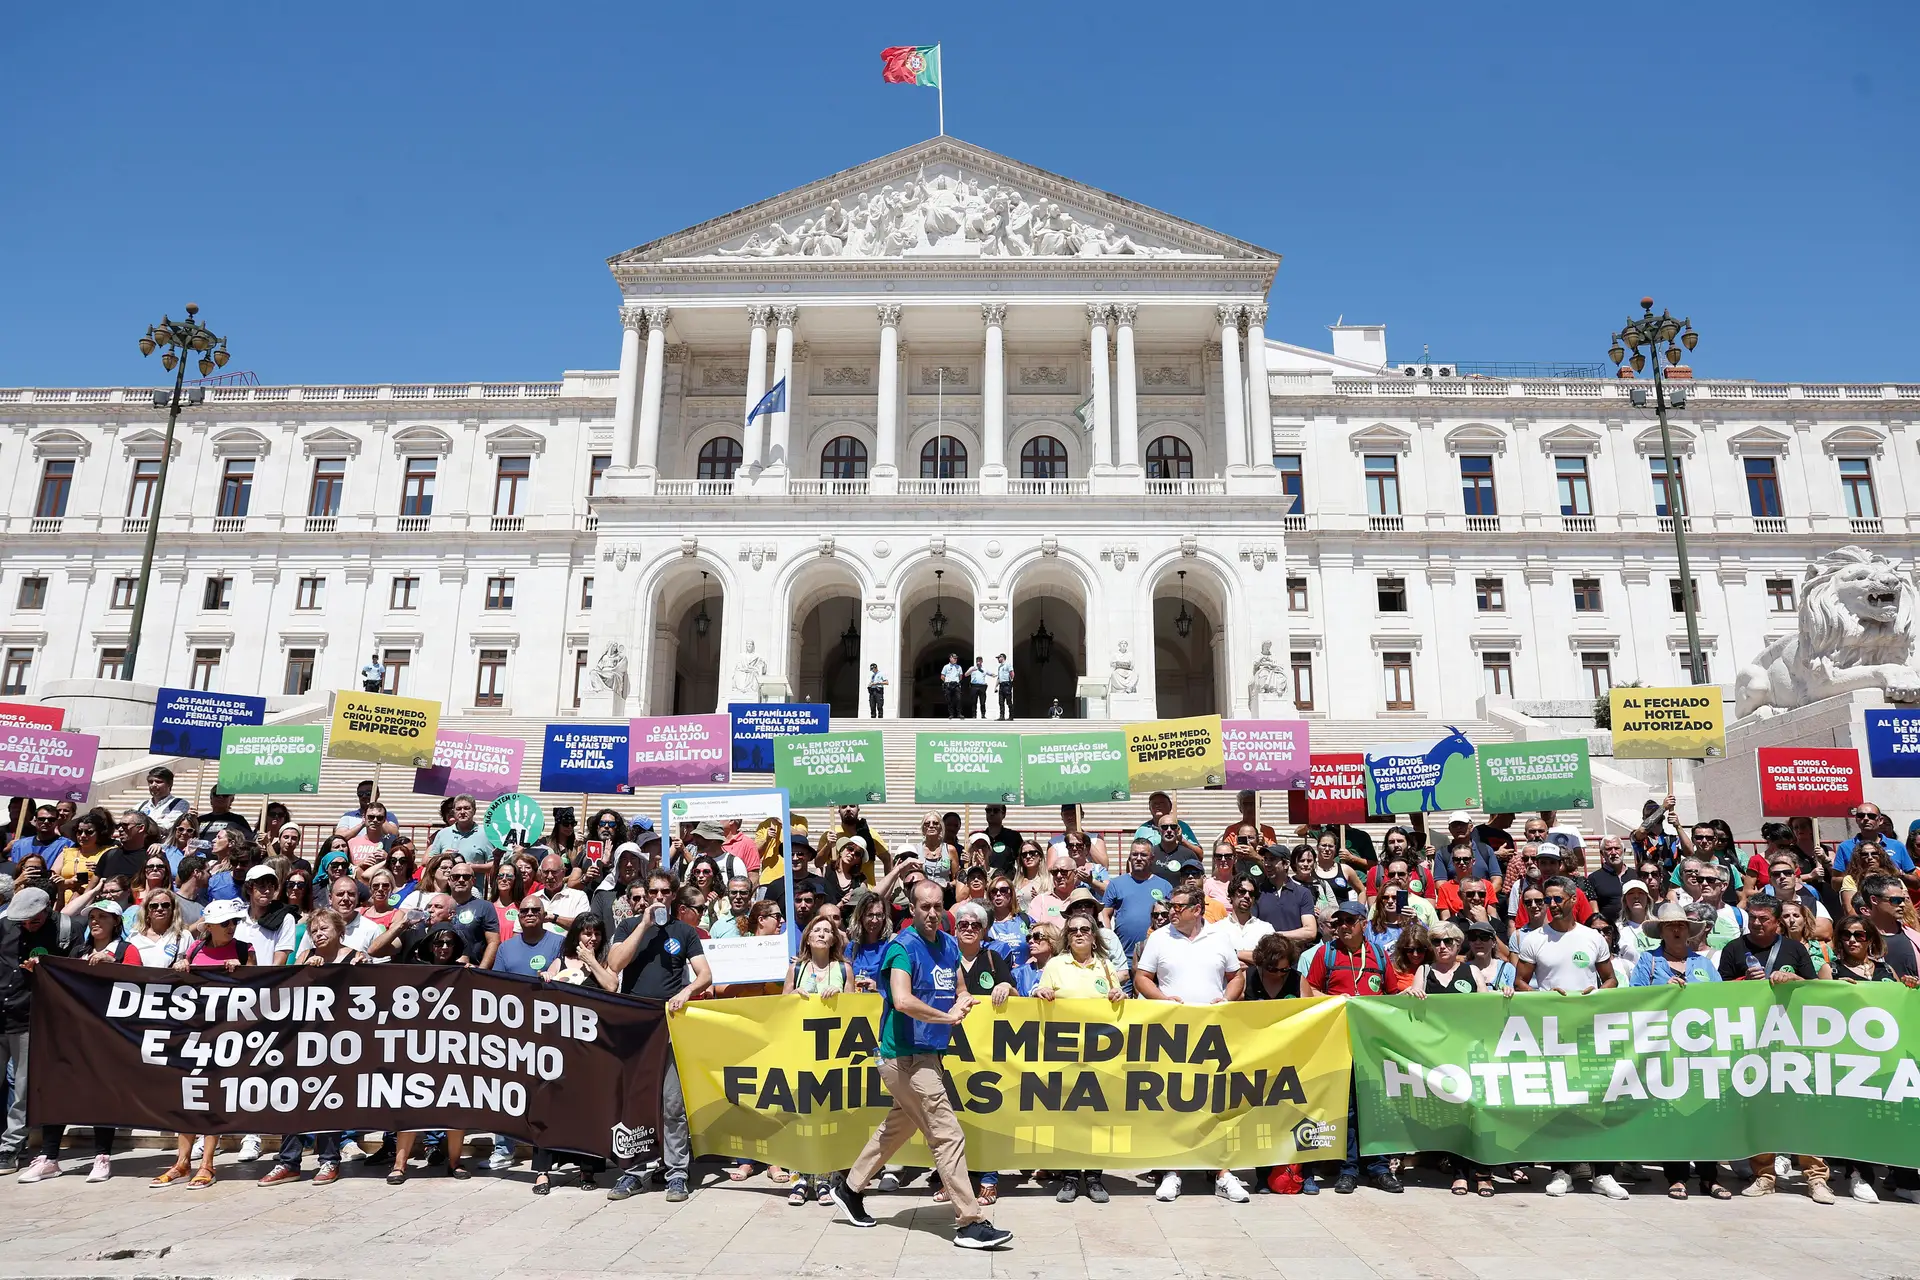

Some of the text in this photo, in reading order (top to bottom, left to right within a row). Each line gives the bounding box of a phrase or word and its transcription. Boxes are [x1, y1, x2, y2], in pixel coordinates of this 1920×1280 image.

[191, 697, 232, 708] FAMÍLIAS
[1623, 698, 1710, 708] AL FECHADO
[167, 703, 252, 717] PORTUGAL PASSAM
[185, 710, 217, 720] FÉRIAS
[357, 705, 372, 713] AL,
[374, 707, 395, 715] SEM
[397, 709, 427, 719] MEDO,
[759, 709, 797, 717] FAMÍLIAS
[1645, 710, 1690, 719] HOTEL
[162, 717, 221, 728] ALOJAMENTO
[343, 712, 373, 721] CRIOU
[384, 717, 426, 728] PRÓPRIO
[1893, 718, 1900, 726] É
[349, 721, 419, 737] EMPREGO
[663, 725, 678, 733] AL
[680, 722, 703, 732] NÃO
[755, 724, 785, 732] FÉRIAS
[1623, 722, 1713, 731] AUTORIZADO
[240, 735, 287, 743] HABITAÇÃO
[566, 733, 572, 742] É
[582, 735, 627, 743] SUSTENTO
[646, 731, 709, 742] DESALOJOU
[1158, 732, 1178, 740] SEM
[1180, 729, 1210, 738] MEDO,
[1222, 729, 1293, 740] NÃO MATEM
[1902, 735, 1917, 743] 55
[20, 737, 36, 745] AL
[39, 738, 67, 748] NÃO
[823, 739, 868, 748] PORTUGAL
[1040, 742, 1090, 752] HABITAÇÃO
[1131, 744, 1158, 752] CRIOU
[1170, 737, 1211, 748] PRÓPRIO
[1232, 742, 1295, 750] ECONOMIA
[0, 743, 73, 757] DESALOJOU
[226, 744, 315, 755] DESEMPREGO
[474, 744, 514, 754] TURISMO
[803, 748, 846, 756] DINAMIZA
[1139, 746, 1206, 762] EMPREGO
[32, 755, 48, 763] AL
[255, 753, 283, 765] NÃO
[433, 748, 509, 765] PORTUGAL
[570, 751, 605, 759] 55 MIL
[636, 749, 722, 762] REABILITOU
[793, 753, 865, 766] ECONOMIA
[934, 754, 1002, 763] ECONOMIA
[1028, 750, 1121, 764] DESEMPREGO
[1249, 752, 1292, 760] MATEM
[1487, 754, 1579, 767] 60 MIL POSTOS
[432, 757, 451, 767] NO
[454, 761, 510, 775] ABISMO
[560, 758, 613, 769] FAMÍLIAS
[1060, 761, 1090, 774] NÃO
[1243, 762, 1271, 771] O AL
[1389, 758, 1395, 766] O
[807, 764, 851, 775] LOCAL
[947, 763, 989, 773] LOCAL
[1373, 764, 1440, 777] EXPIATÓRIO
[1491, 763, 1578, 776] DE TRABALHO
[1768, 765, 1853, 774] BODE EXPIATÓRIO
[1376, 776, 1395, 784] PARA
[1407, 772, 1440, 781] GOVERNO
[1497, 772, 1574, 782] VÃO DESAPARECER
[1380, 778, 1436, 791] SEM SOLUÇÕES
[1798, 781, 1849, 792] SOLUÇÕES
[491, 795, 510, 811] MATEM
[503, 829, 530, 847] AL
[1637, 938, 1655, 947] AL
[105, 985, 599, 1043] DESTRUIR 3,8% DO PIB
[1494, 1005, 1900, 1057] AL FECHADO
[803, 1017, 1232, 1064] TAA MEDINA
[141, 1028, 564, 1081] E 40% DO TURISMO
[724, 1054, 1308, 1114] FAMÍLS NA RUÍNA
[1384, 1058, 1589, 1106] HOTEL
[182, 1069, 527, 1118] É 100% INSANO
[621, 1130, 647, 1143] MATEM
[1312, 1139, 1332, 1148] LOCAL
[624, 1145, 650, 1155] LOCAL
